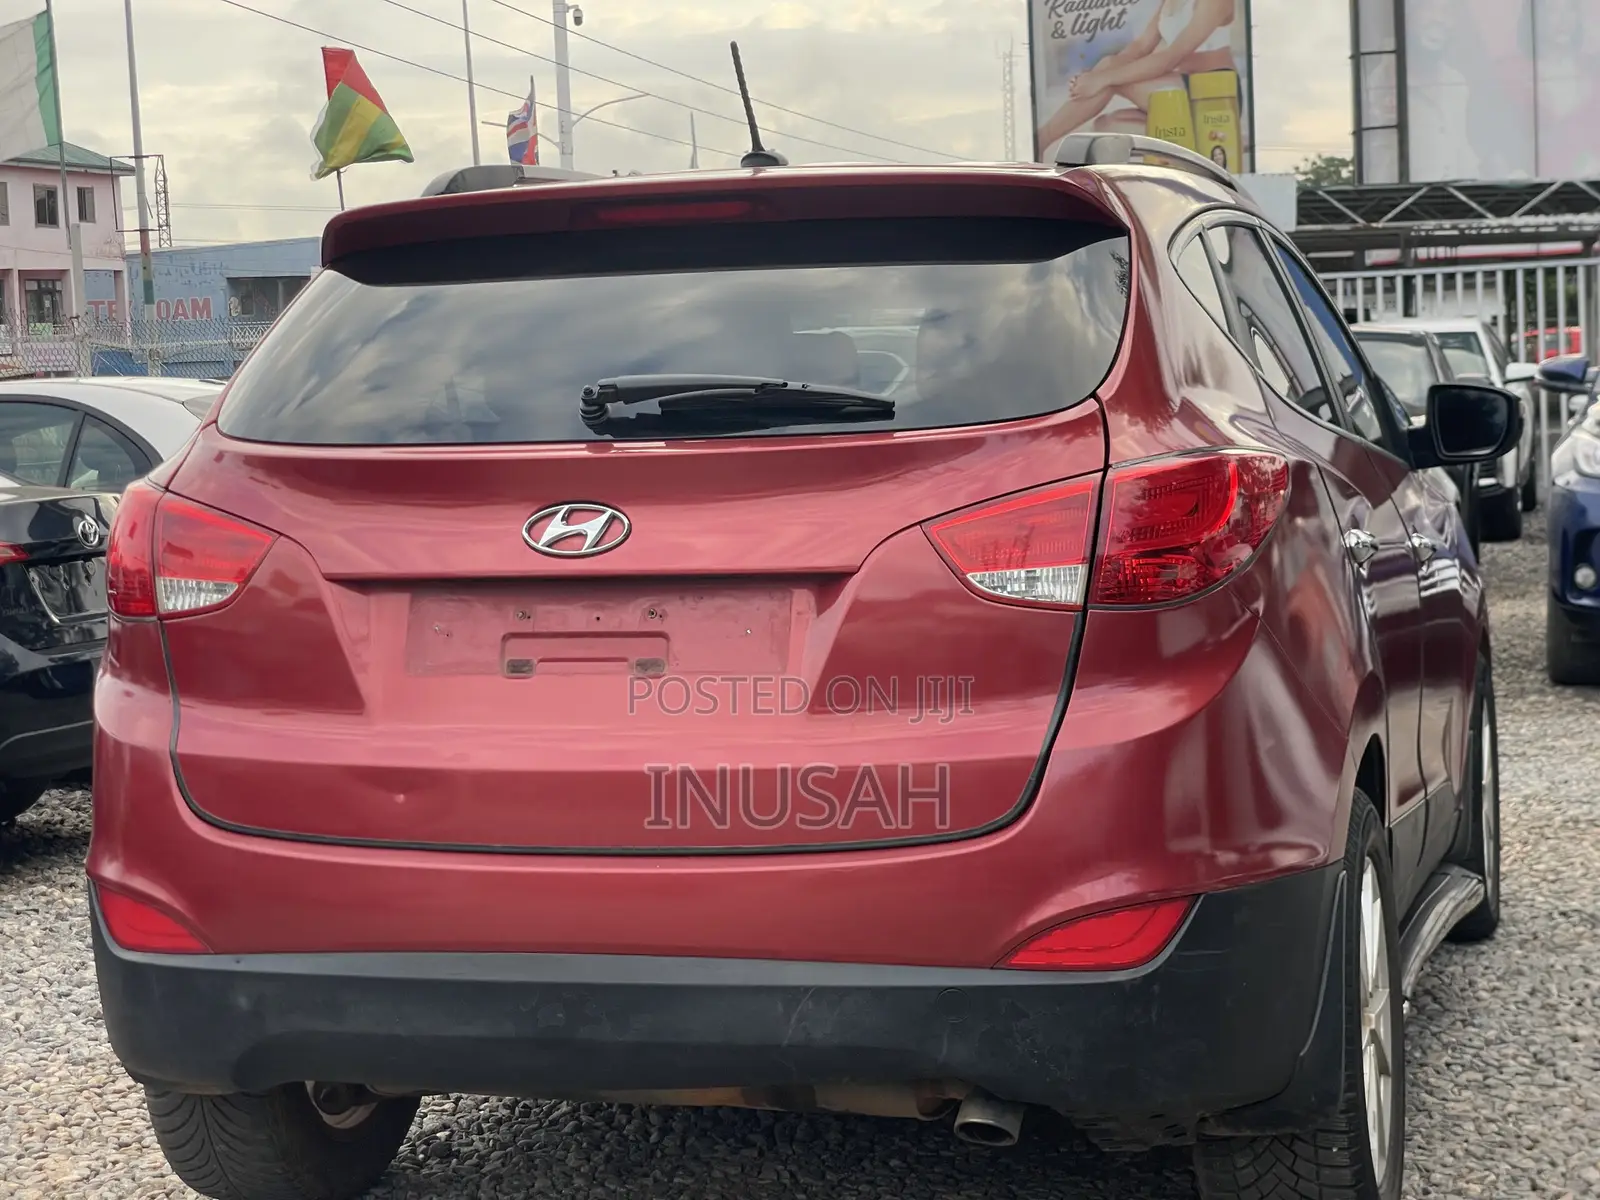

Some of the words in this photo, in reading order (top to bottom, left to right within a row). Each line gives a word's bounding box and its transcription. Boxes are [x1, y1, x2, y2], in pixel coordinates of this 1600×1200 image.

[1050, 20, 1067, 39] &
[1070, 7, 1128, 43] light
[1155, 126, 1186, 138] Insta
